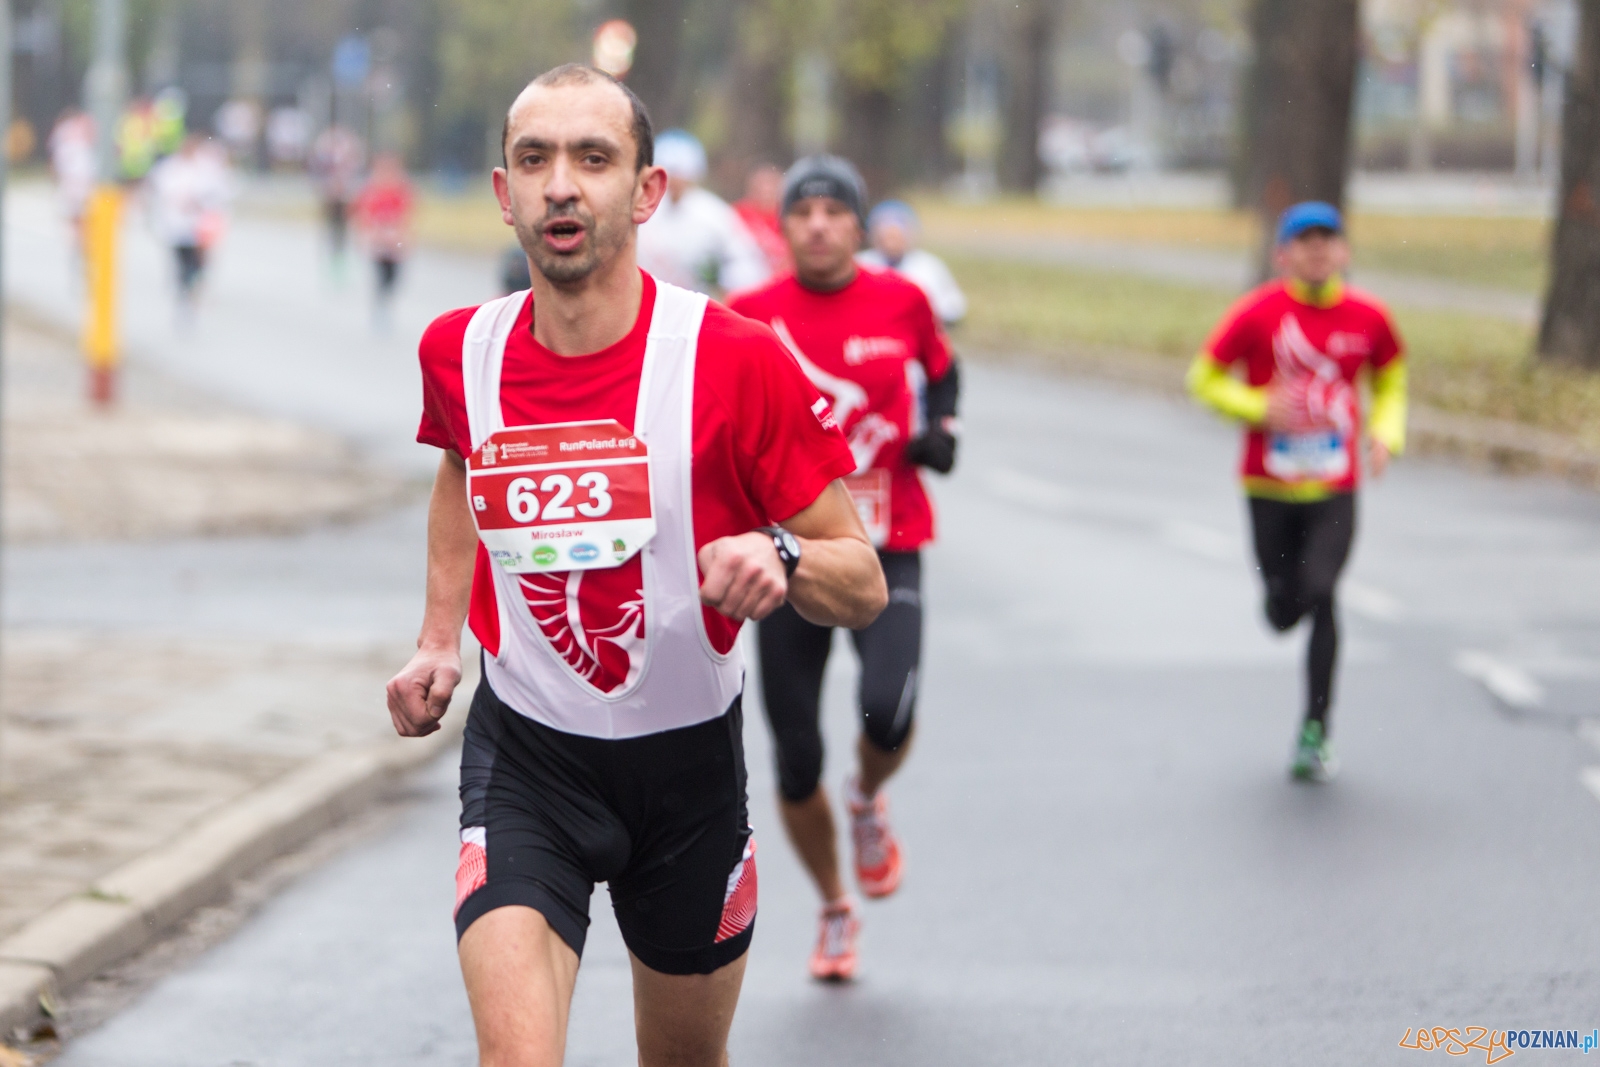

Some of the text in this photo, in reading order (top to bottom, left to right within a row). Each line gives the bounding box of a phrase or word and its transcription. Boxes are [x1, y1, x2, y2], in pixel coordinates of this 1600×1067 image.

[559, 437, 637, 452] RunPoland.org
[473, 495, 487, 511] B
[506, 471, 613, 523] 623
